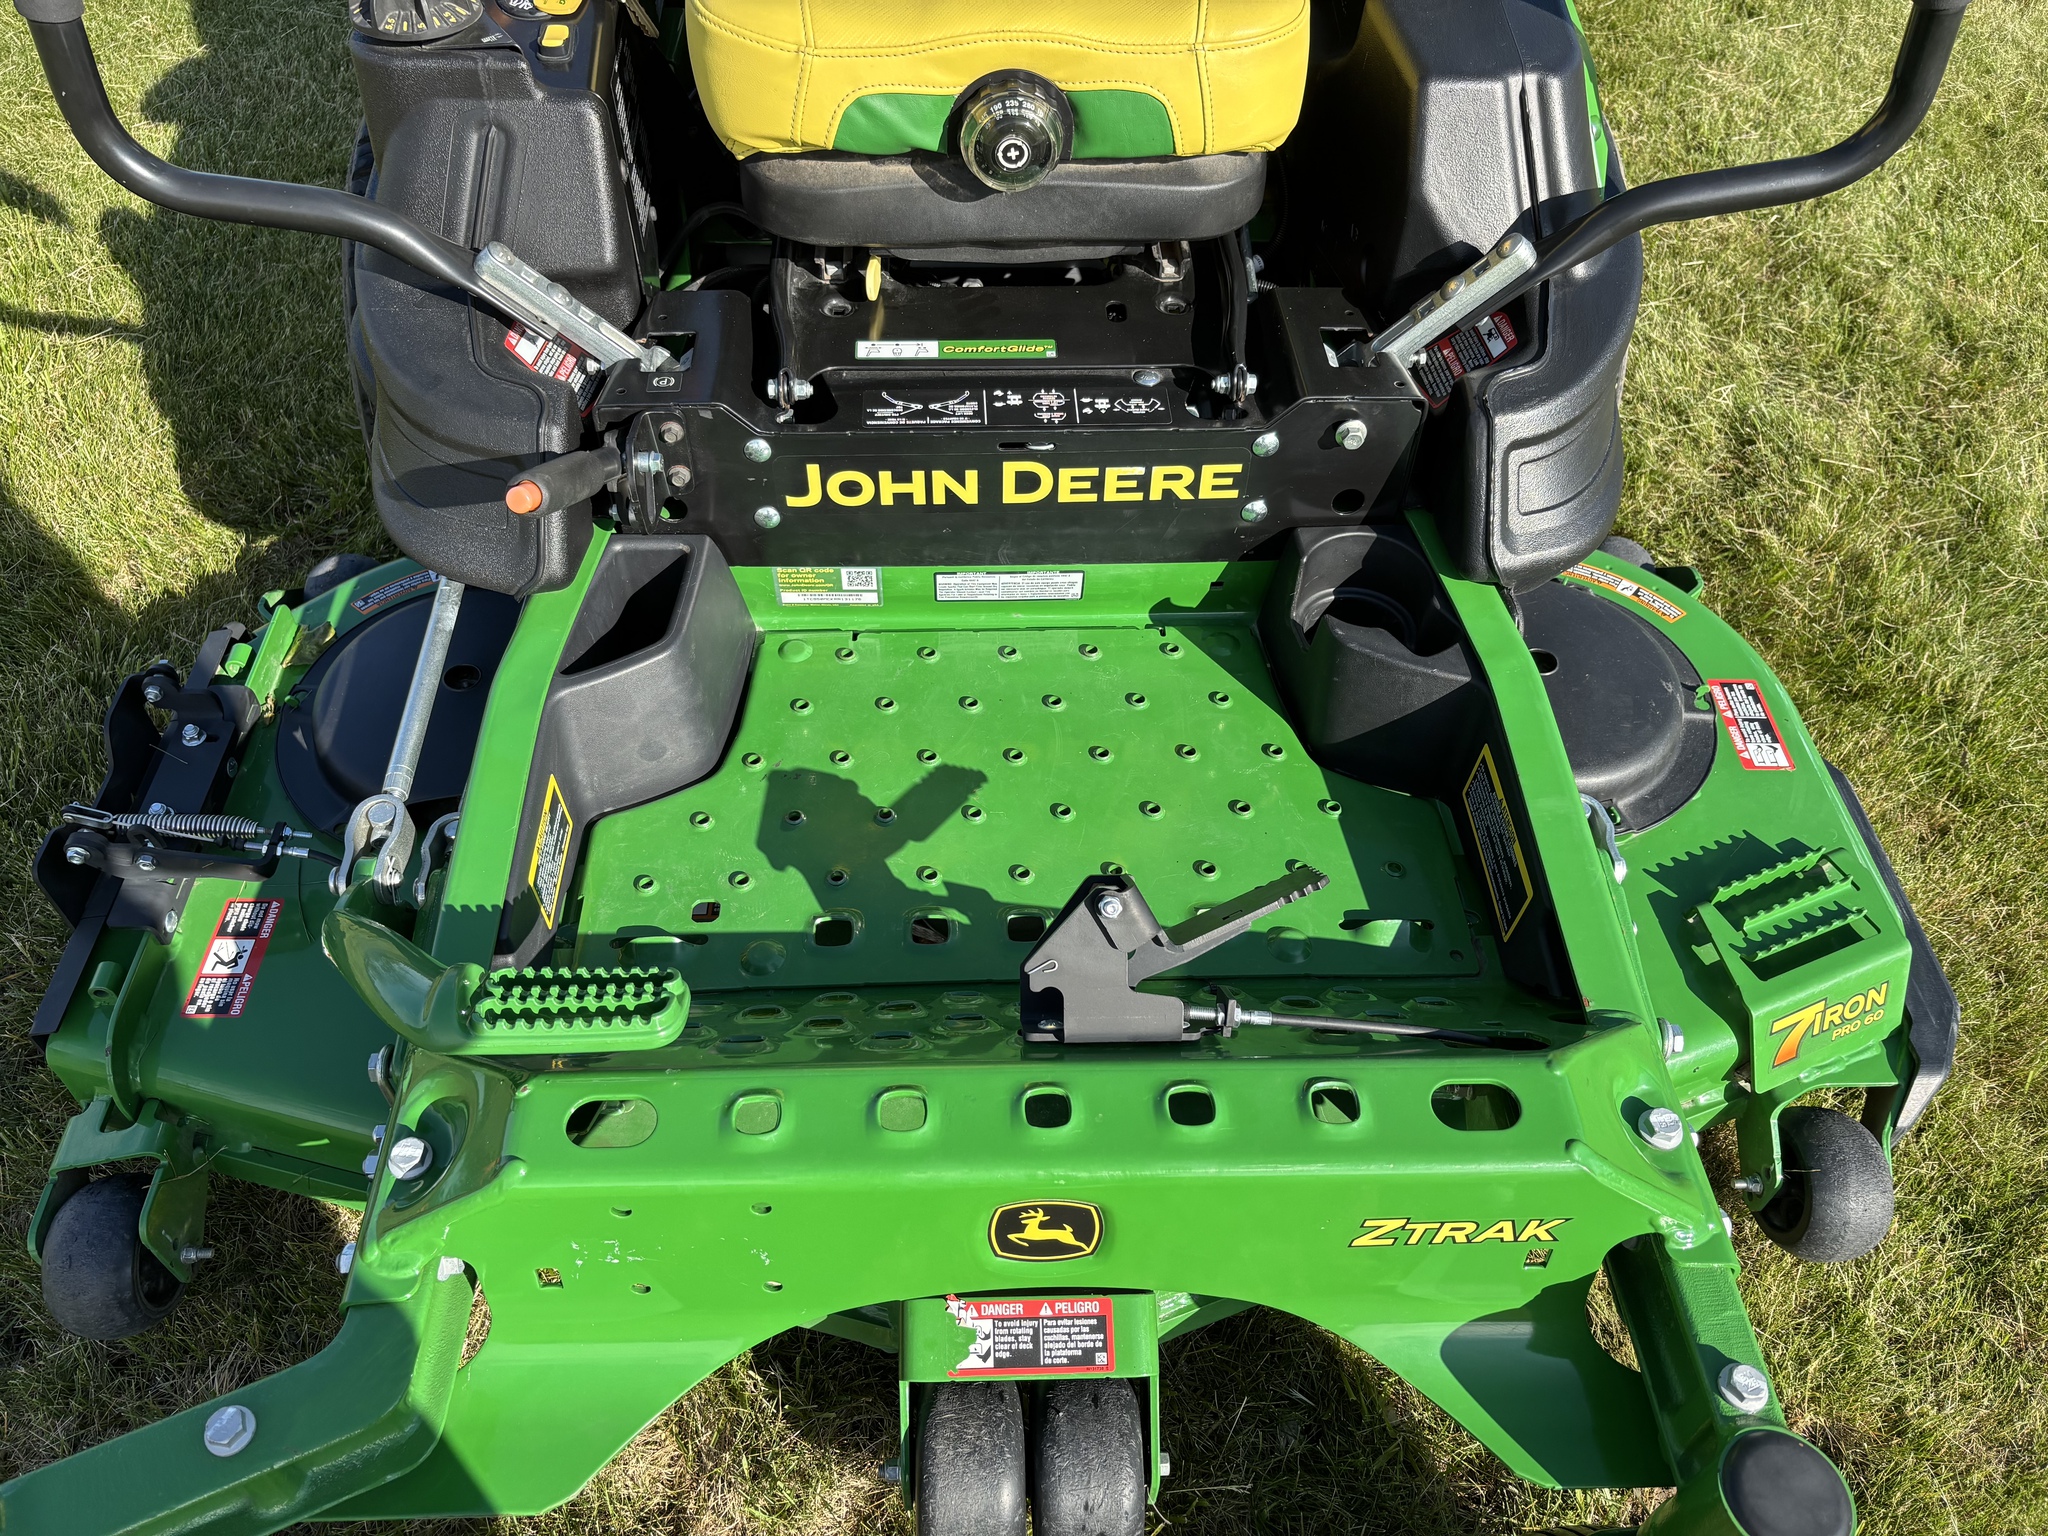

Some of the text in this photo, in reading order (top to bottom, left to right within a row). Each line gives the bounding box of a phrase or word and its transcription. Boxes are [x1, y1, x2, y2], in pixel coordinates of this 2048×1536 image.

[989, 102, 1003, 114] 190
[1021, 101, 1036, 111] 280
[1499, 317, 1515, 343] DANGER
[1447, 353, 1463, 377] PELIGRO
[786, 461, 1244, 508] JOHN DEERE
[1711, 685, 1729, 710] PELIGRO
[1728, 726, 1747, 750] DANGER
[259, 908, 278, 937] DANGER
[230, 981, 251, 1014] PELIGRO
[1831, 1009, 1885, 1042] PRO 60
[1348, 1217, 1574, 1248] ZTRAK
[981, 1304, 1023, 1315] DANGER
[1055, 1302, 1100, 1313] PELIGRO
[1021, 1320, 1038, 1328] injury
[1018, 1335, 1031, 1343] stay
[1051, 1348, 1082, 1356] plataforma
